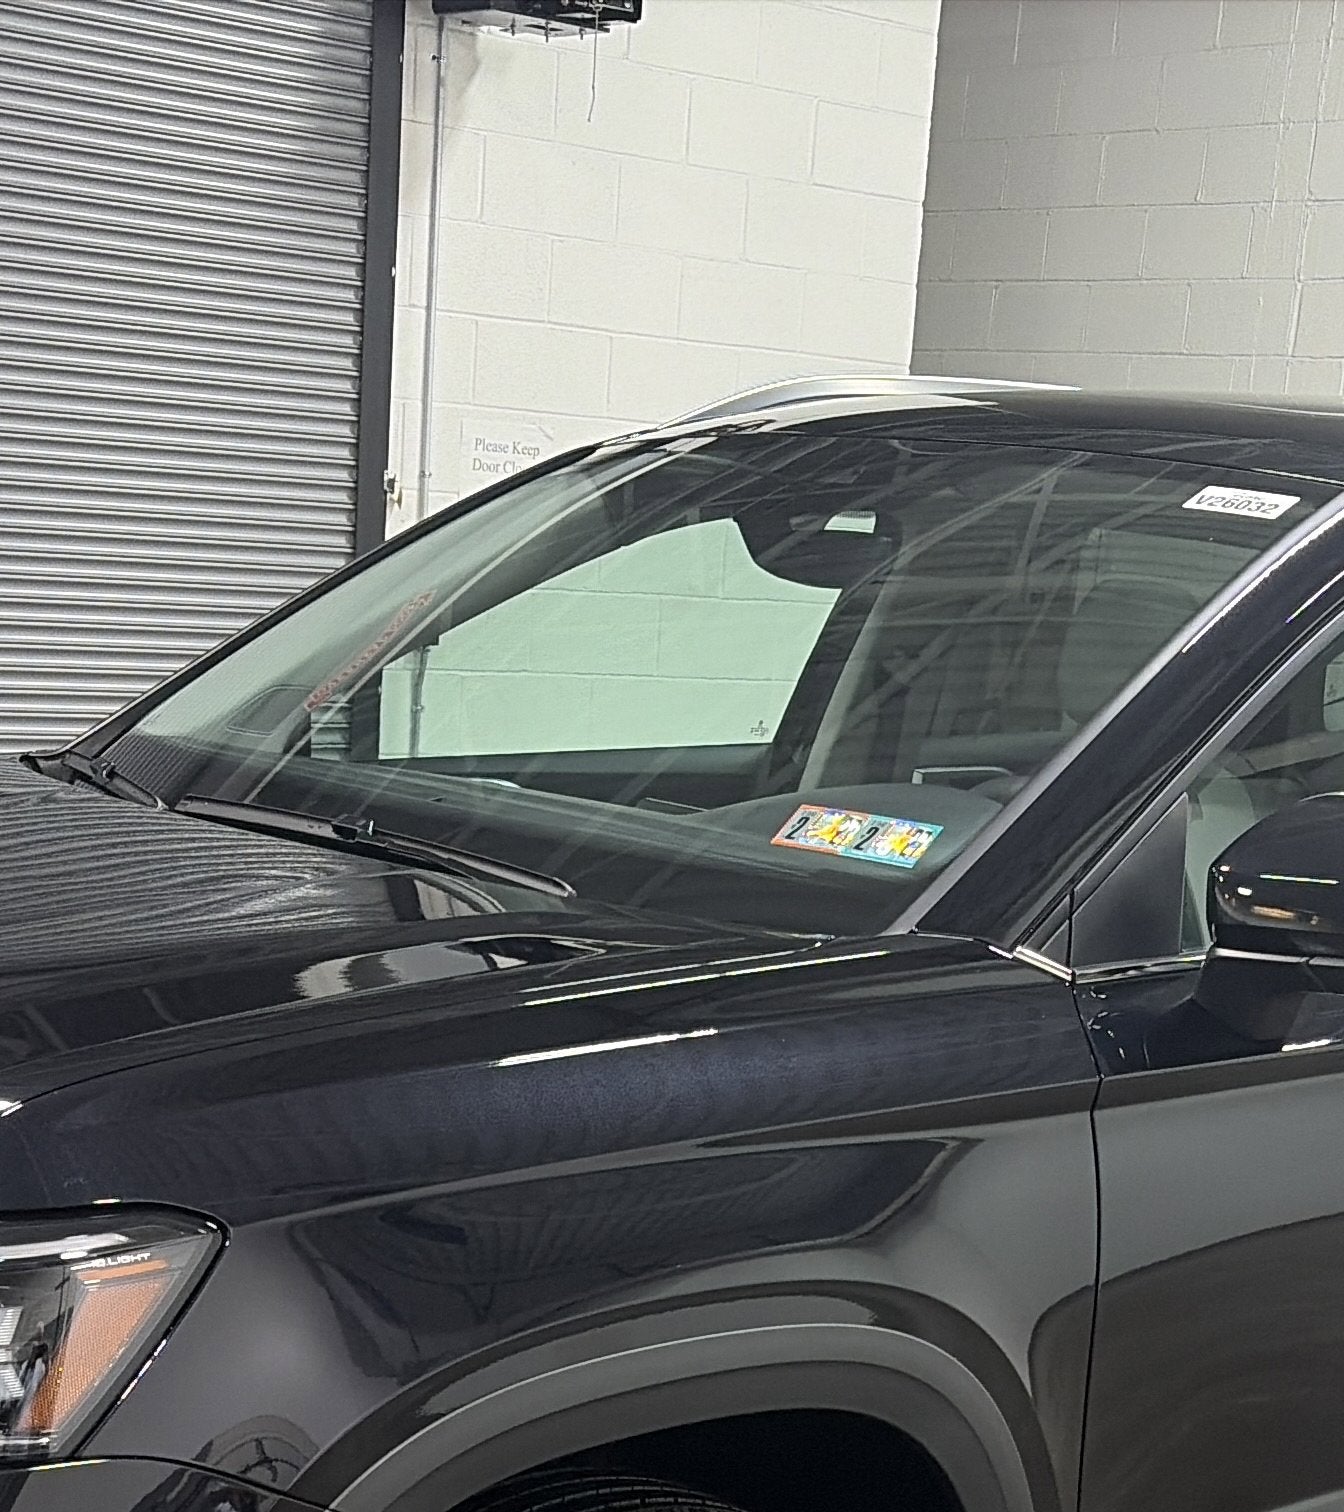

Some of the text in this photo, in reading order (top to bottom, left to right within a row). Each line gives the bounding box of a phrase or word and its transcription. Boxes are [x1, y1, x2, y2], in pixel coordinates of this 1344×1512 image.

[474, 437, 541, 460] Please Keep
[472, 457, 502, 474] Door
[1195, 494, 1280, 515] V26032
